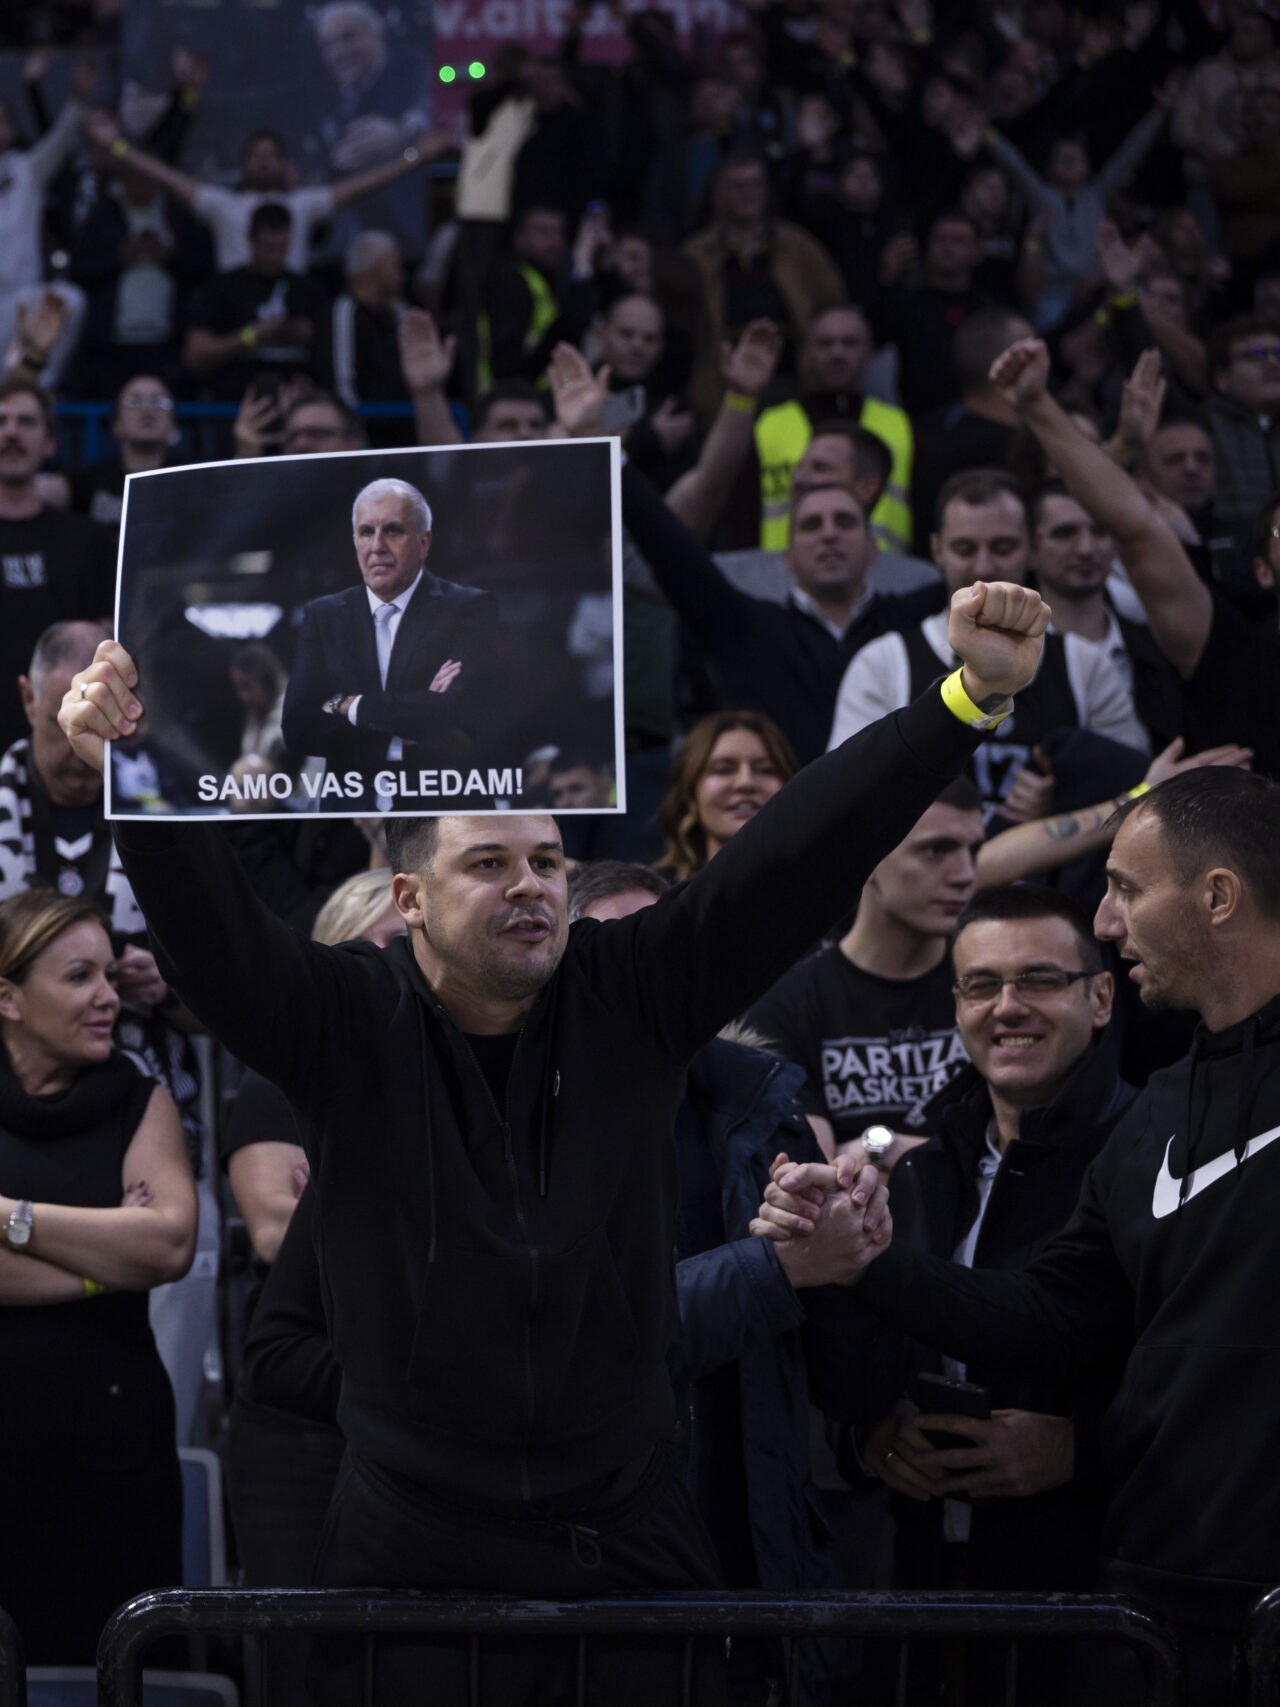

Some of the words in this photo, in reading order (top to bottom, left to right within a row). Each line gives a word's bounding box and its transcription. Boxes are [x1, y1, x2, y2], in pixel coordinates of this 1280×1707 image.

[198, 773, 293, 801] SAMO
[300, 771, 364, 799] VAS
[374, 768, 524, 797] GLEDAM!
[822, 1033, 972, 1083] PARTIZA
